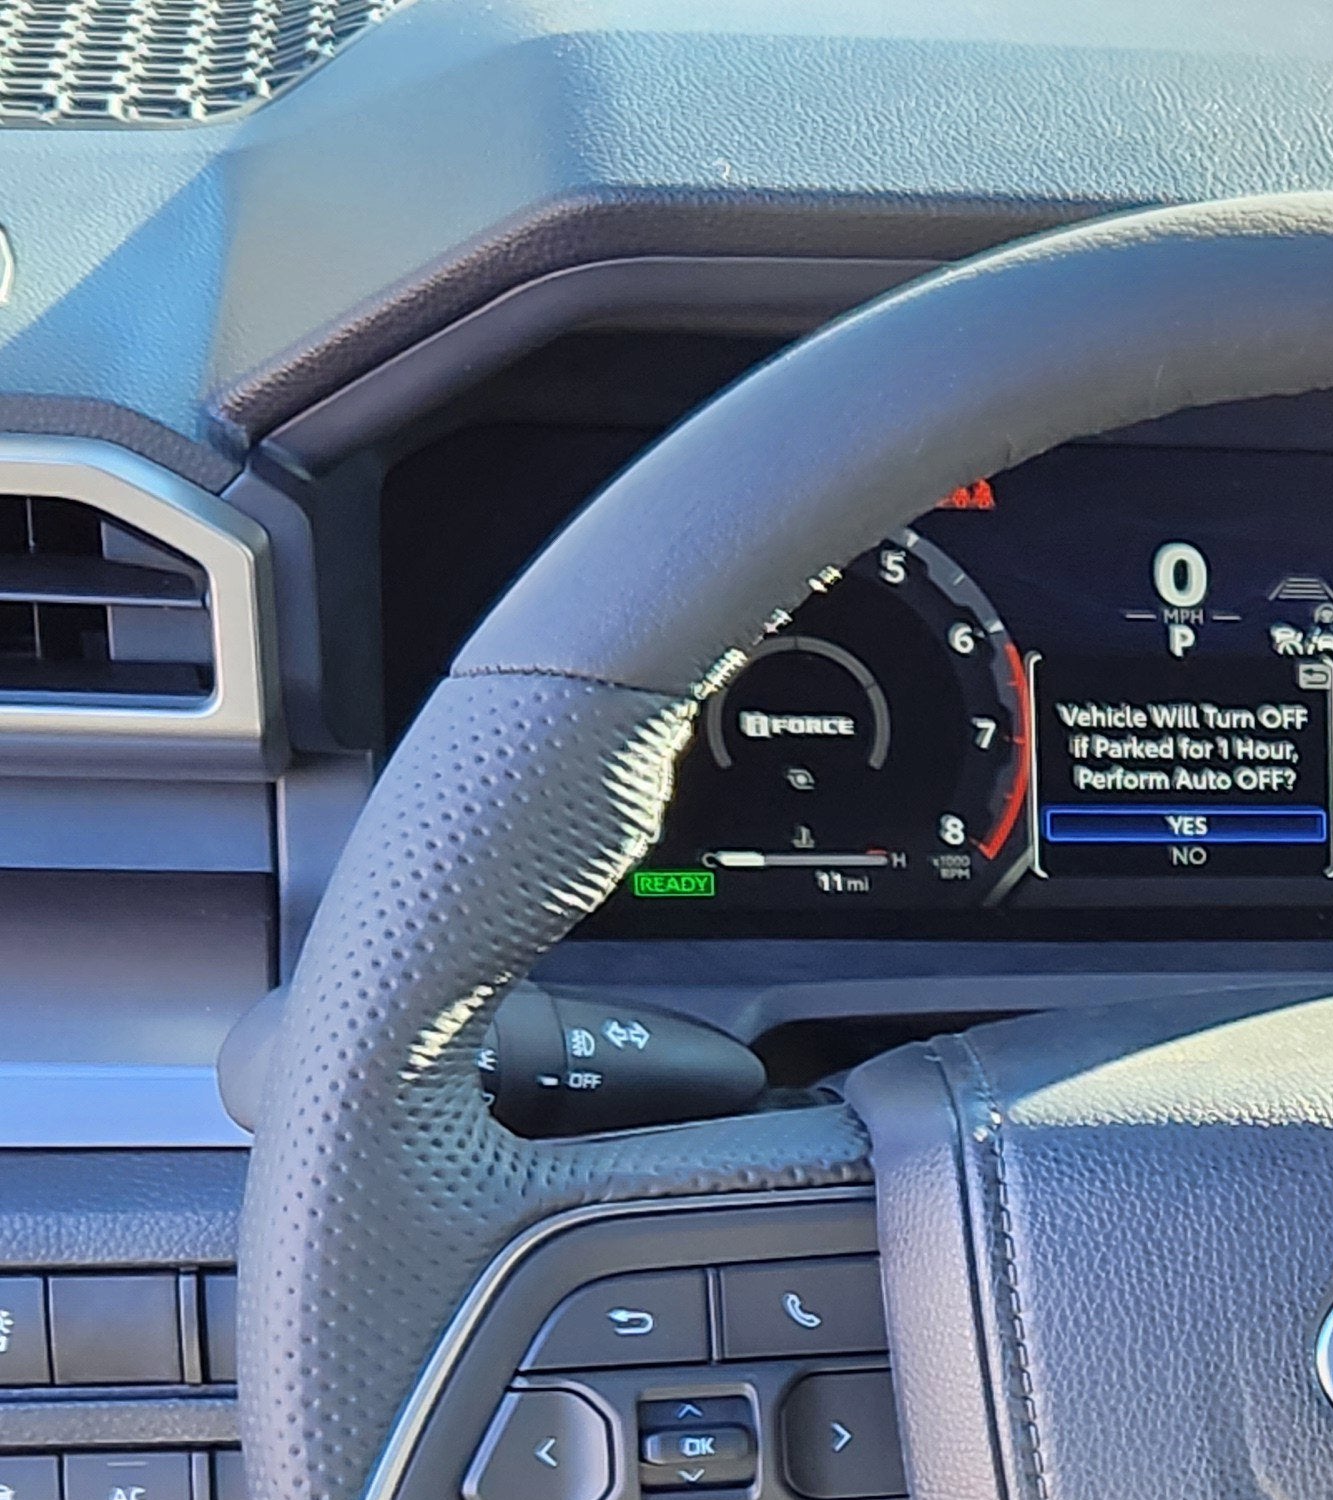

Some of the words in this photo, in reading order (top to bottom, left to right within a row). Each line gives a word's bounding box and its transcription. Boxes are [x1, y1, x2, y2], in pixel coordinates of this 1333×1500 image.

[881, 550, 906, 584] 5
[1154, 542, 1208, 607] 0
[1164, 610, 1204, 624] MPH
[948, 623, 974, 654] 6
[1170, 625, 1195, 657] P
[1057, 703, 1147, 728] Vehicle
[1149, 703, 1200, 728] Will
[1202, 703, 1255, 728] Turn
[1258, 705, 1308, 729] OFF
[971, 718, 996, 749] 7
[1070, 735, 1089, 758] If
[1092, 734, 1174, 759] Parked
[1178, 735, 1214, 759] for
[1217, 736, 1229, 759] 1
[1234, 735, 1299, 763] Hour,
[1074, 765, 1170, 790] Perform
[1174, 766, 1231, 790] Auto
[1235, 766, 1297, 791] OFF?
[940, 815, 965, 845] 8
[1165, 816, 1208, 835] YES
[892, 853, 906, 868] H
[1170, 847, 1207, 865] NO
[639, 876, 708, 893] READY
[817, 871, 843, 891] 11
[847, 877, 869, 892] mi
[568, 1073, 601, 1089] OFF
[680, 1436, 717, 1456] OK
